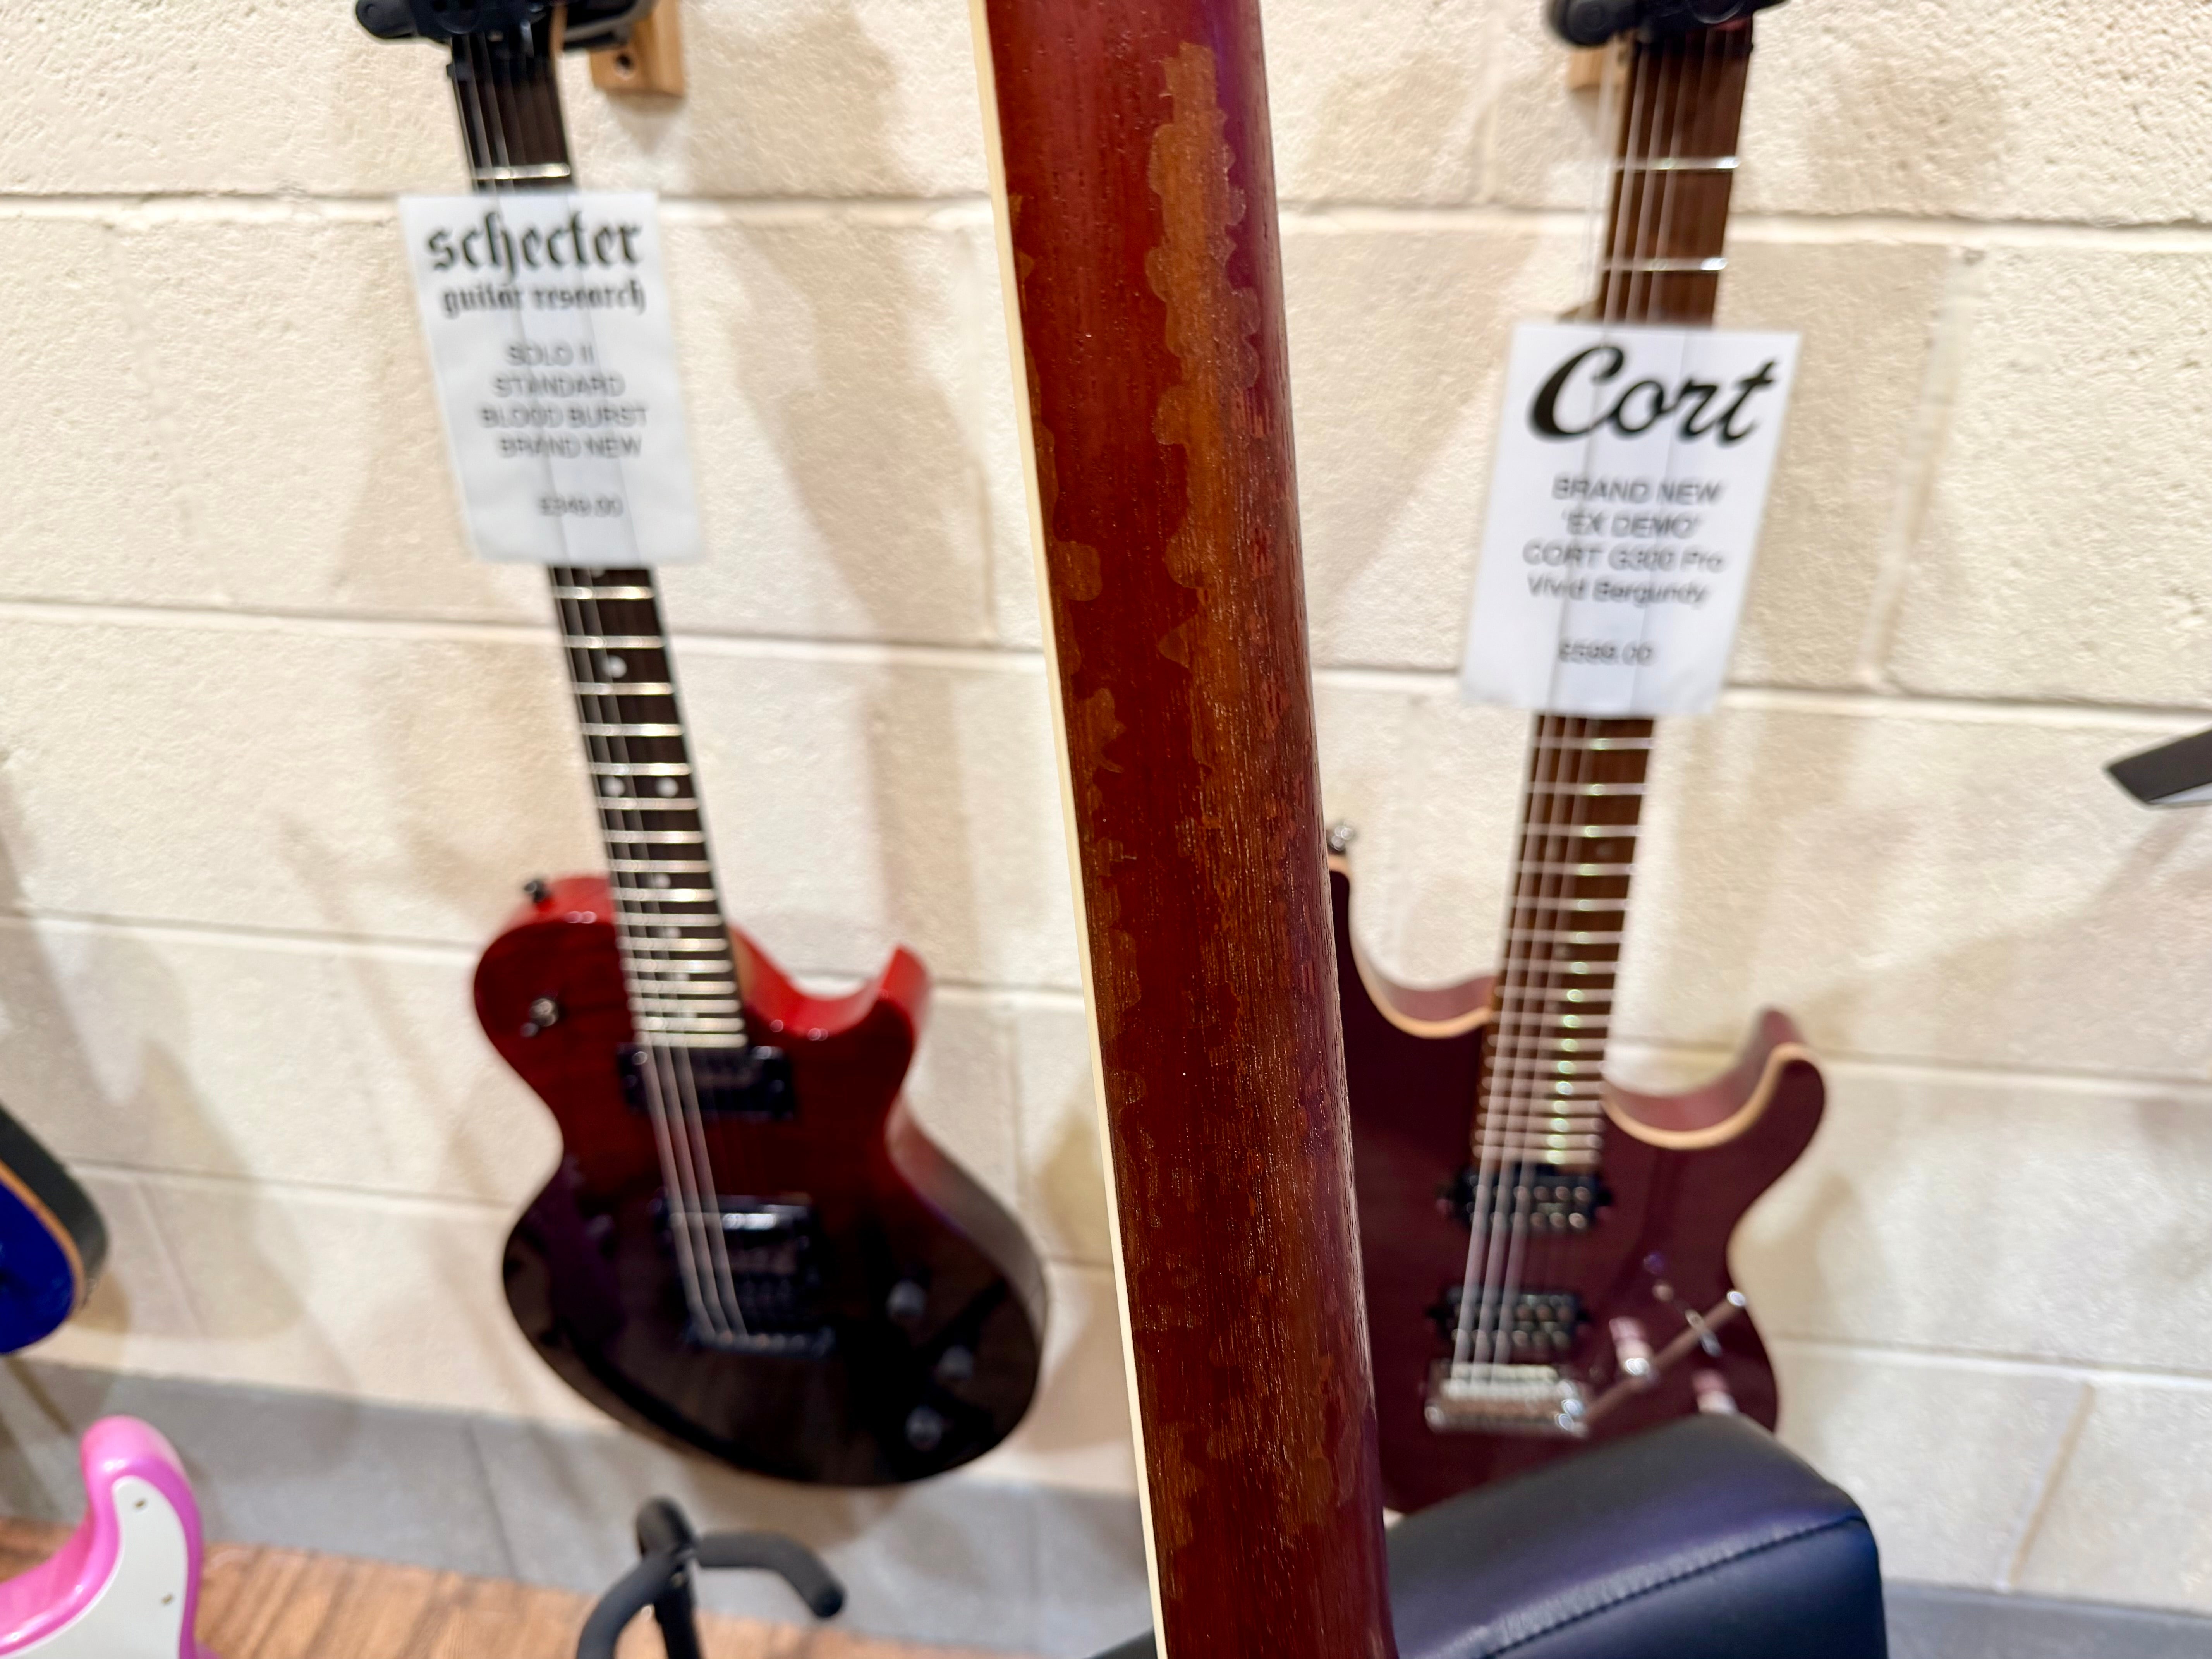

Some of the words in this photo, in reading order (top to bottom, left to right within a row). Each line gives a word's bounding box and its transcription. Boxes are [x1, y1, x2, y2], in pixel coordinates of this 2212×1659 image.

[427, 211, 644, 285] schecter
[443, 285, 523, 319] guitar
[532, 276, 647, 316] research
[506, 344, 574, 366] SOLO
[493, 373, 626, 398] STANDARD
[1527, 343, 1780, 448] Cort
[479, 404, 564, 428] BLOOD
[566, 406, 647, 428] BURST
[497, 435, 581, 459] BRAND
[584, 436, 642, 458] NEW
[1552, 475, 1650, 503] BRAND
[1657, 477, 1728, 503] NEW
[1522, 538, 1604, 567] CORT
[1679, 548, 1728, 574] Pro
[1527, 574, 1587, 601] Vivid
[1592, 575, 1712, 609] Burgundy
